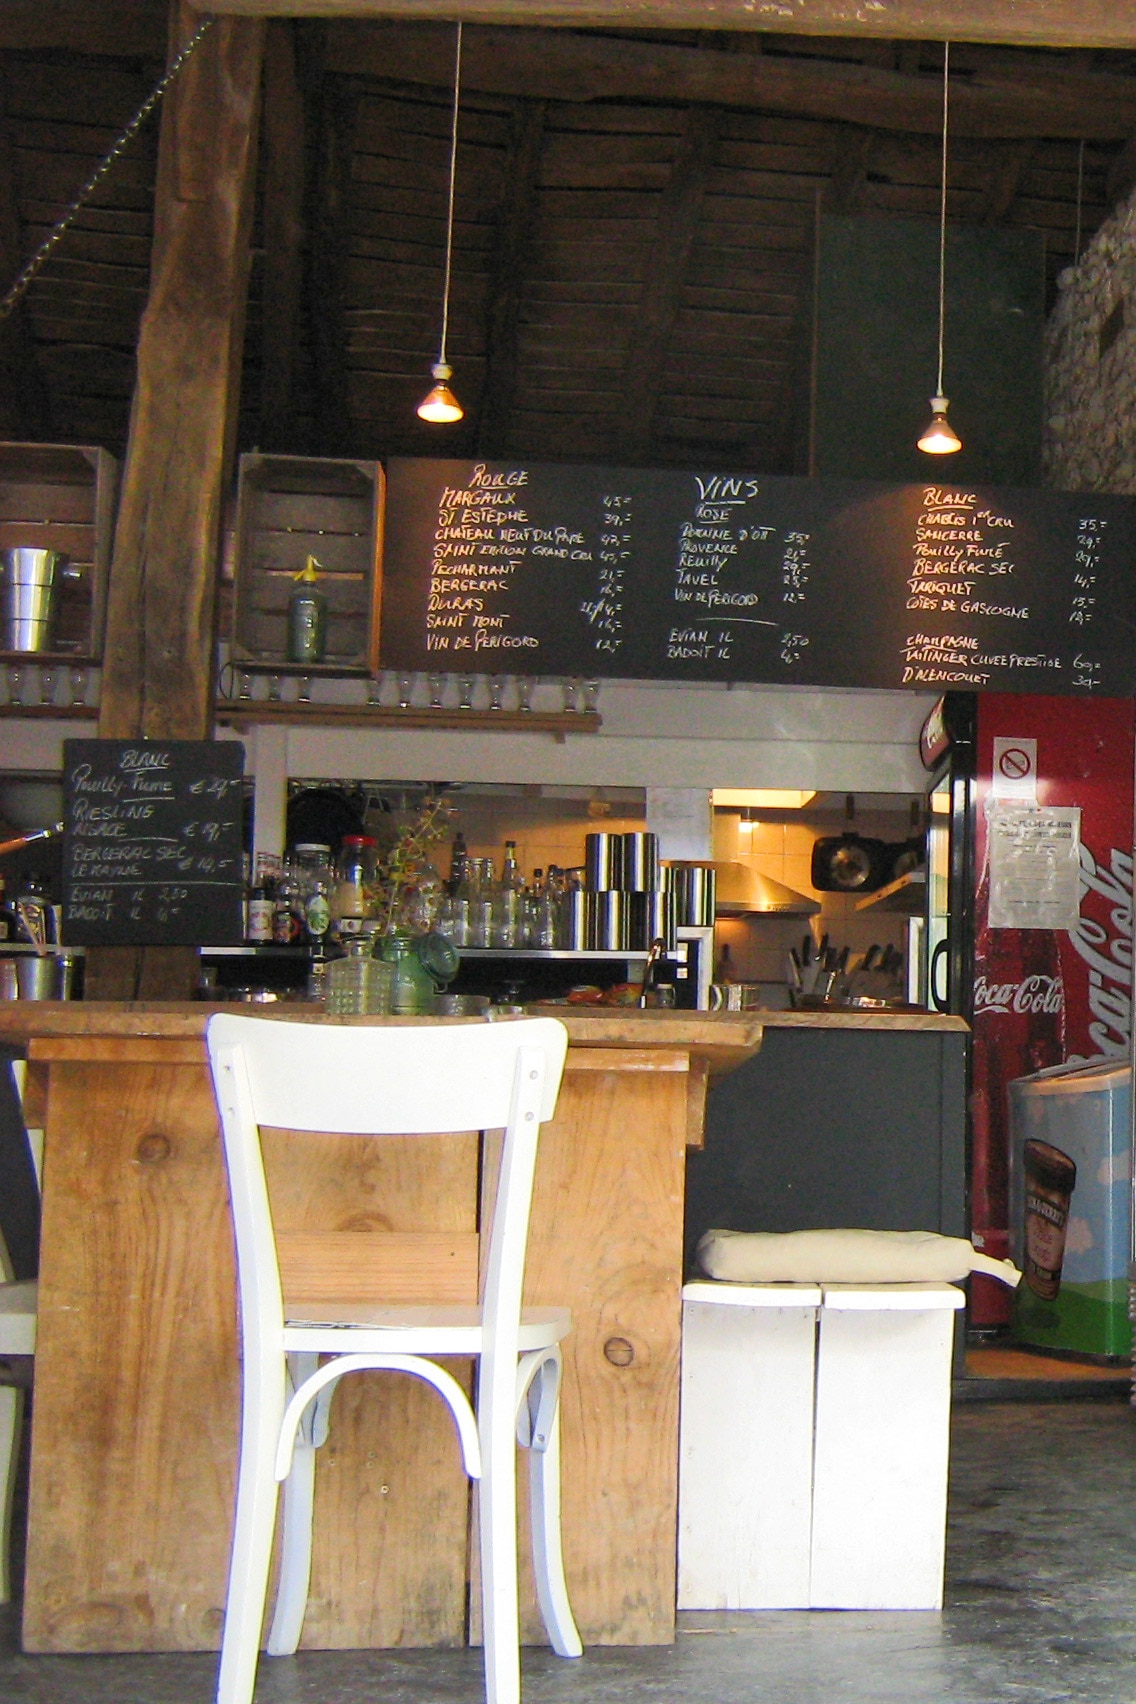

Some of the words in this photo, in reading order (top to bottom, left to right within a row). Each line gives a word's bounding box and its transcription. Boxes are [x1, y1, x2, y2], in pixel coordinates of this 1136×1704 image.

[467, 463, 529, 488] ROUGE
[439, 486, 516, 508] MARGAUX
[923, 487, 978, 507] BLANC
[461, 506, 529, 526] ESTEPHE
[917, 512, 967, 527] CHABLIS
[986, 515, 1015, 528] CRU
[434, 524, 496, 541] CHATEAU
[916, 526, 985, 542] SANCERRE
[433, 542, 481, 558] SAINT
[532, 545, 569, 560] GRAND
[570, 549, 593, 561] CRU
[431, 558, 522, 576] PECHARMANT
[675, 567, 719, 586] TAVEL
[912, 558, 985, 577] BERGERAC
[429, 577, 509, 593] BERGERAC
[906, 576, 977, 596] TARIQUET
[427, 593, 484, 612] DURAS
[940, 598, 957, 612] DE
[960, 599, 1030, 619] GASCOGNE
[426, 612, 469, 630] SAINT
[472, 613, 511, 628] MONT
[453, 635, 473, 650] DE
[906, 633, 979, 650] CHAMPAGNE
[119, 749, 171, 769] BLANC
